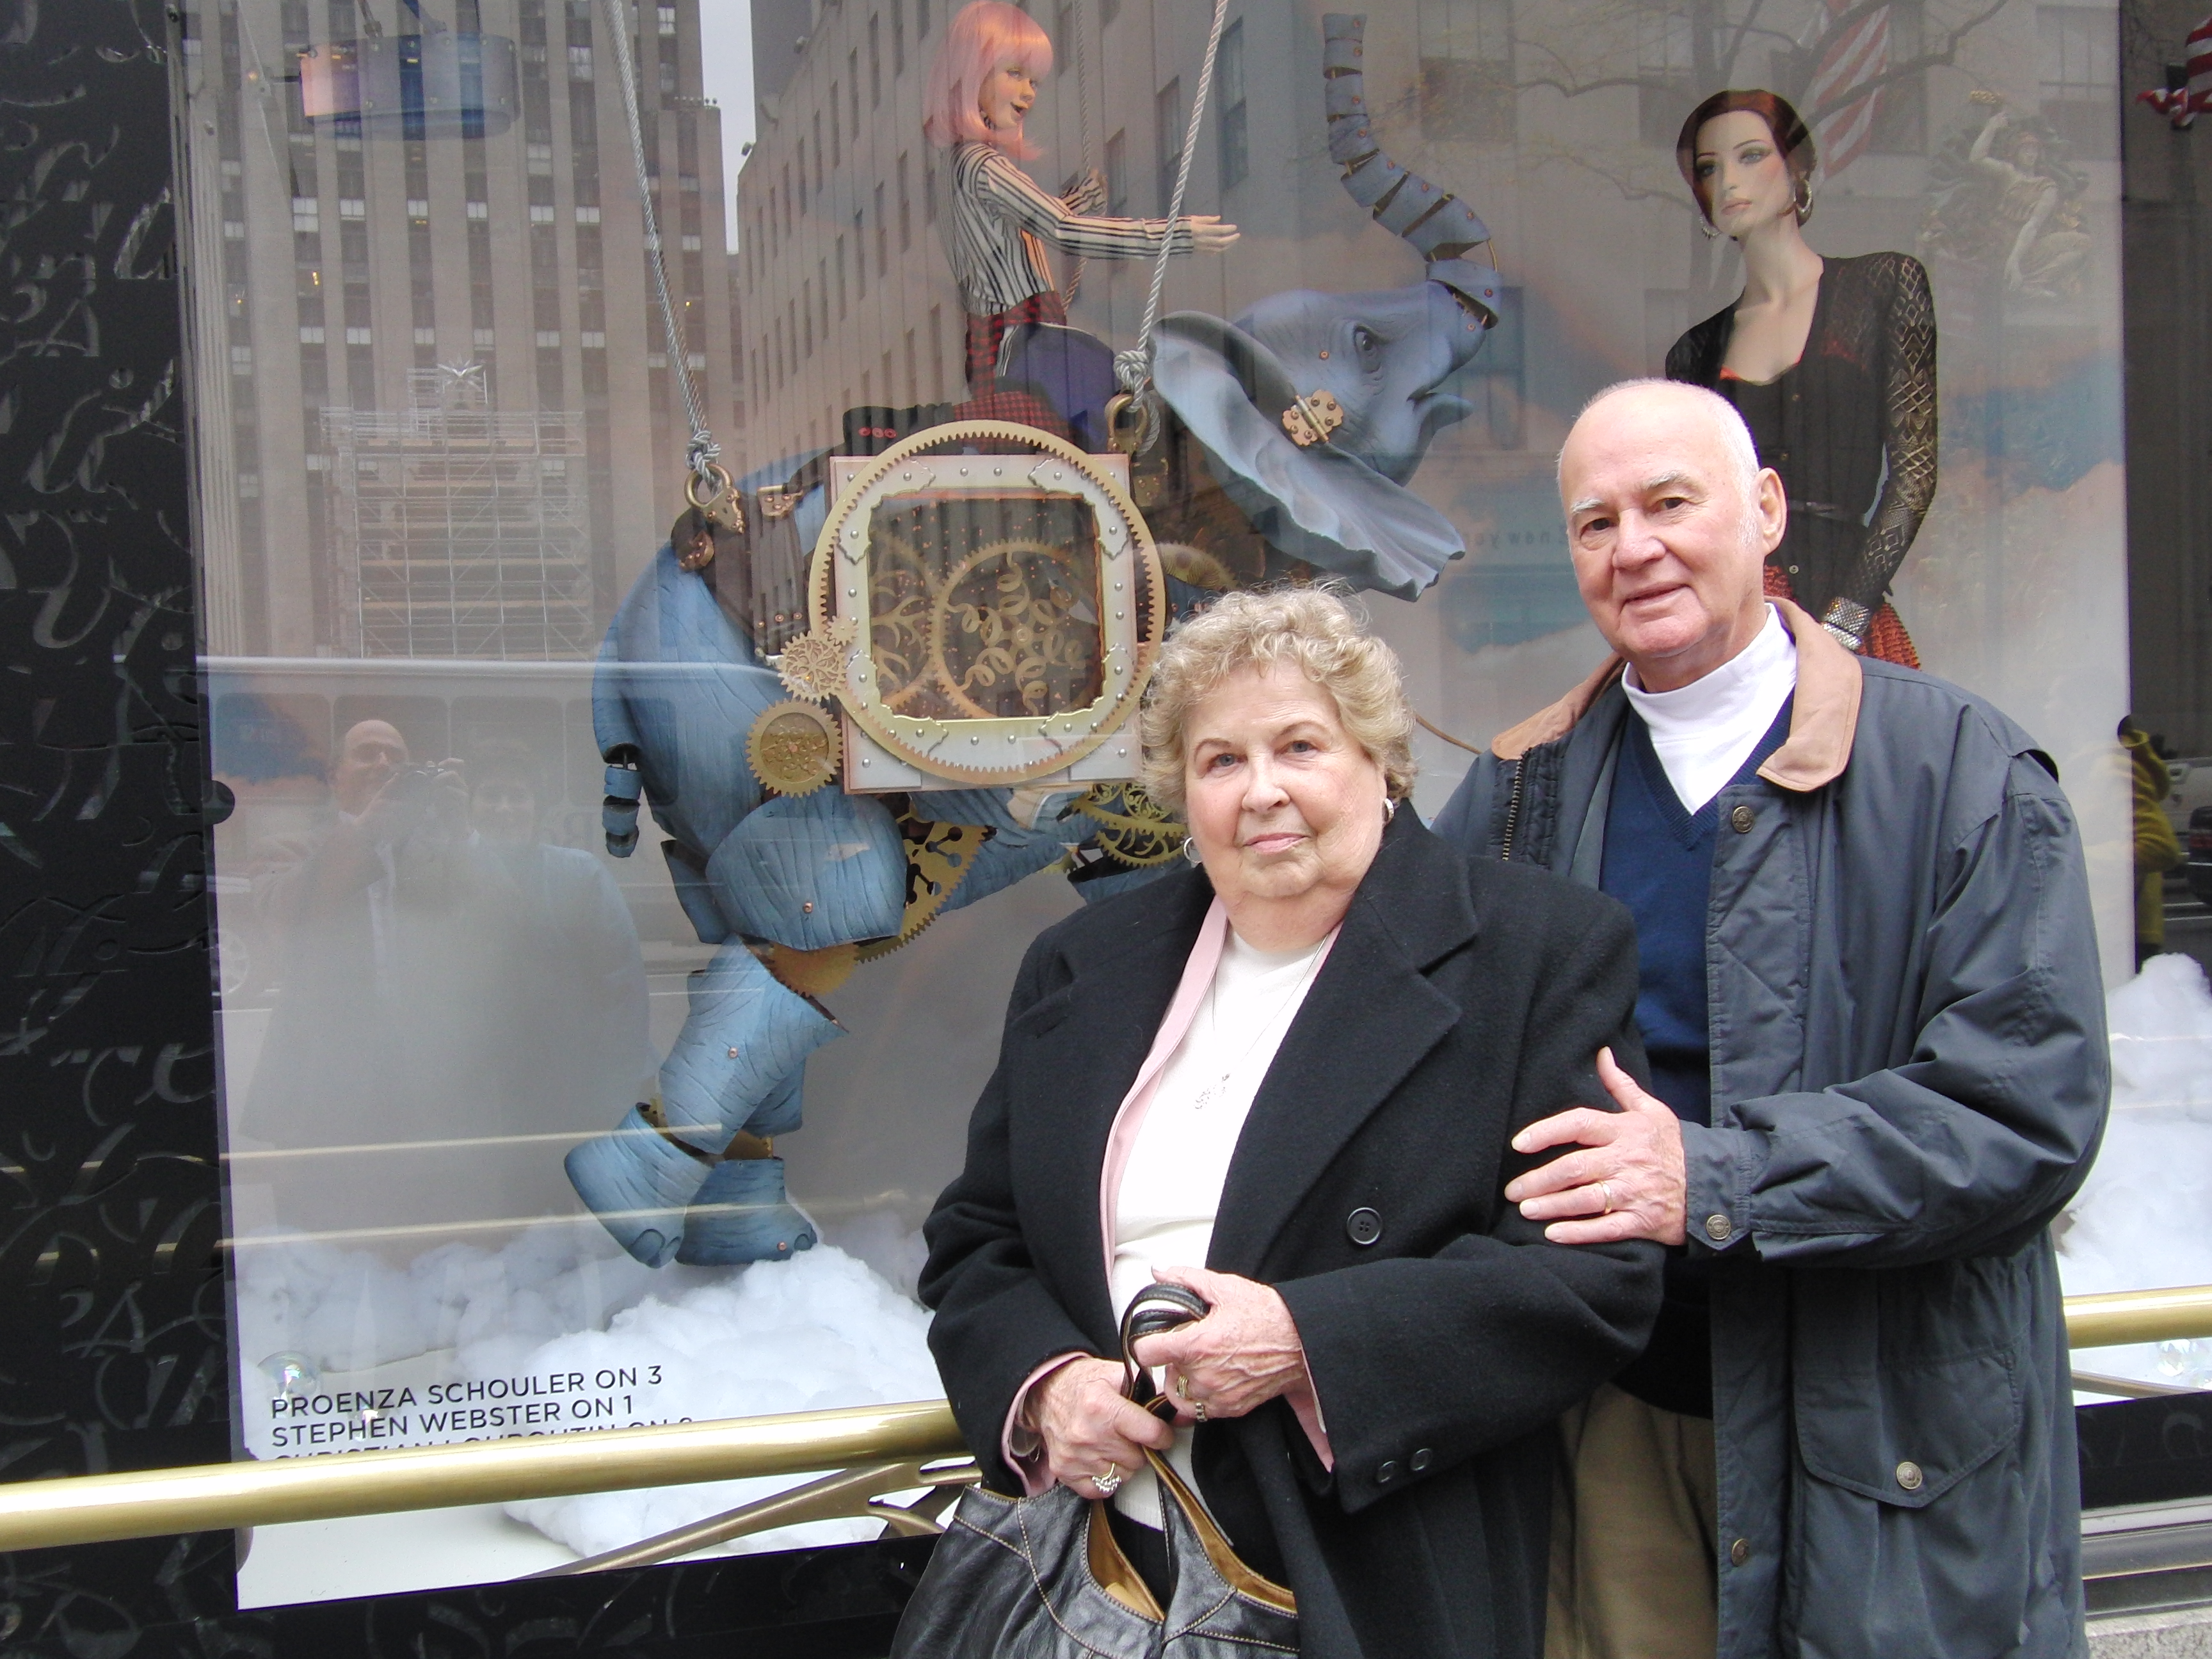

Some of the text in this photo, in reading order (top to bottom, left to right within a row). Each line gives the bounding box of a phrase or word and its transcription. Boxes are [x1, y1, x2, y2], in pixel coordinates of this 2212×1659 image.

[271, 1365, 662, 1419] PROENZA SCHOULER ON 3
[272, 1395, 632, 1447] STEPHEN WEBSTER ON 1
